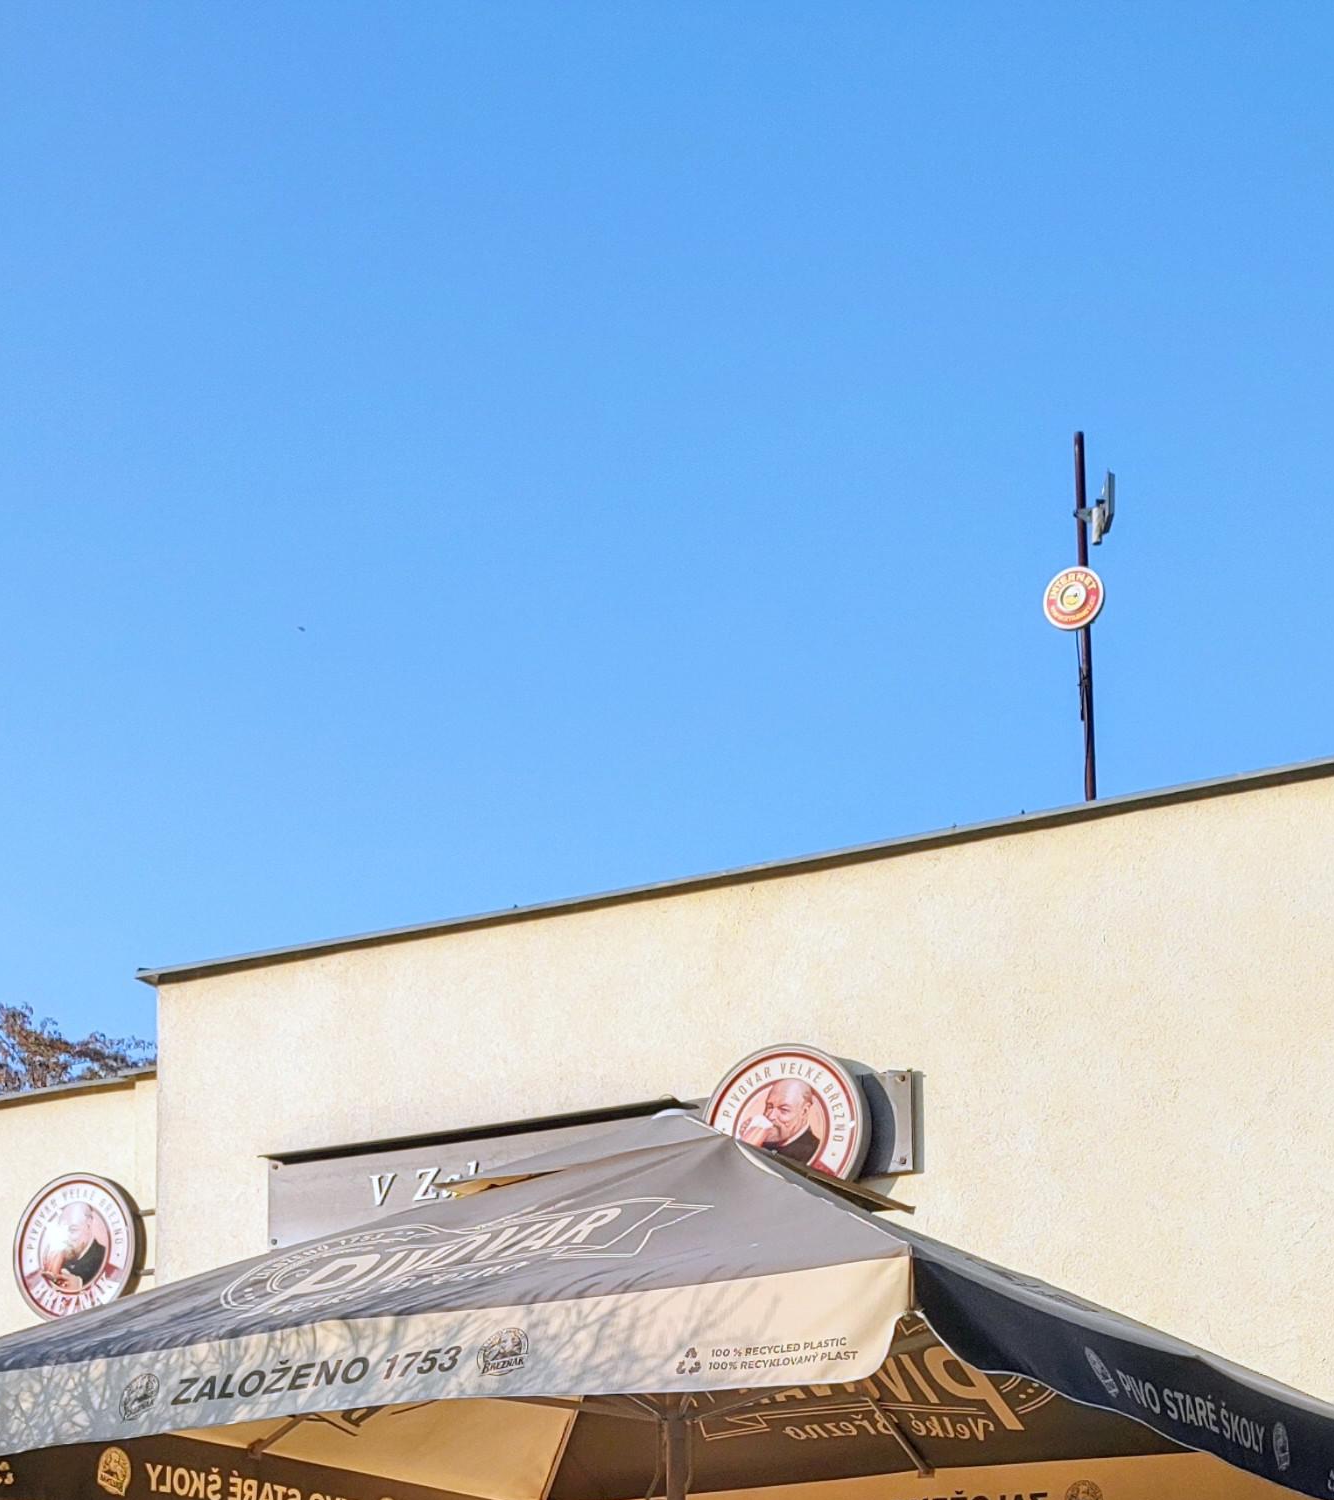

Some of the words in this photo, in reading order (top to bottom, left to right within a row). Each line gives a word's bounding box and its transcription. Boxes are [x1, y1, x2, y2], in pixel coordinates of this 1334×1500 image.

[1049, 572, 1096, 599] INTERNET
[723, 1067, 771, 1118] PIVOVAR
[780, 1062, 825, 1082] VELKÉ
[822, 1083, 846, 1143] BŘEZNO
[369, 1173, 396, 1206] V
[237, 1207, 622, 1319] PIVOVAR
[708, 1361, 738, 1371] 100%
[740, 1352, 818, 1370] RECYKLOVANÝ
[820, 1350, 859, 1362] PLAST
[711, 1348, 731, 1358] 100
[745, 1342, 801, 1357] RECYCLED
[803, 1337, 847, 1350] PLASTIC
[170, 1356, 371, 1407] ZALOŽENO
[382, 1344, 464, 1381] 1753
[1116, 1369, 1161, 1415] PIVO
[1163, 1387, 1219, 1434] STARÉ
[1220, 1401, 1266, 1454] ŠKOLY
